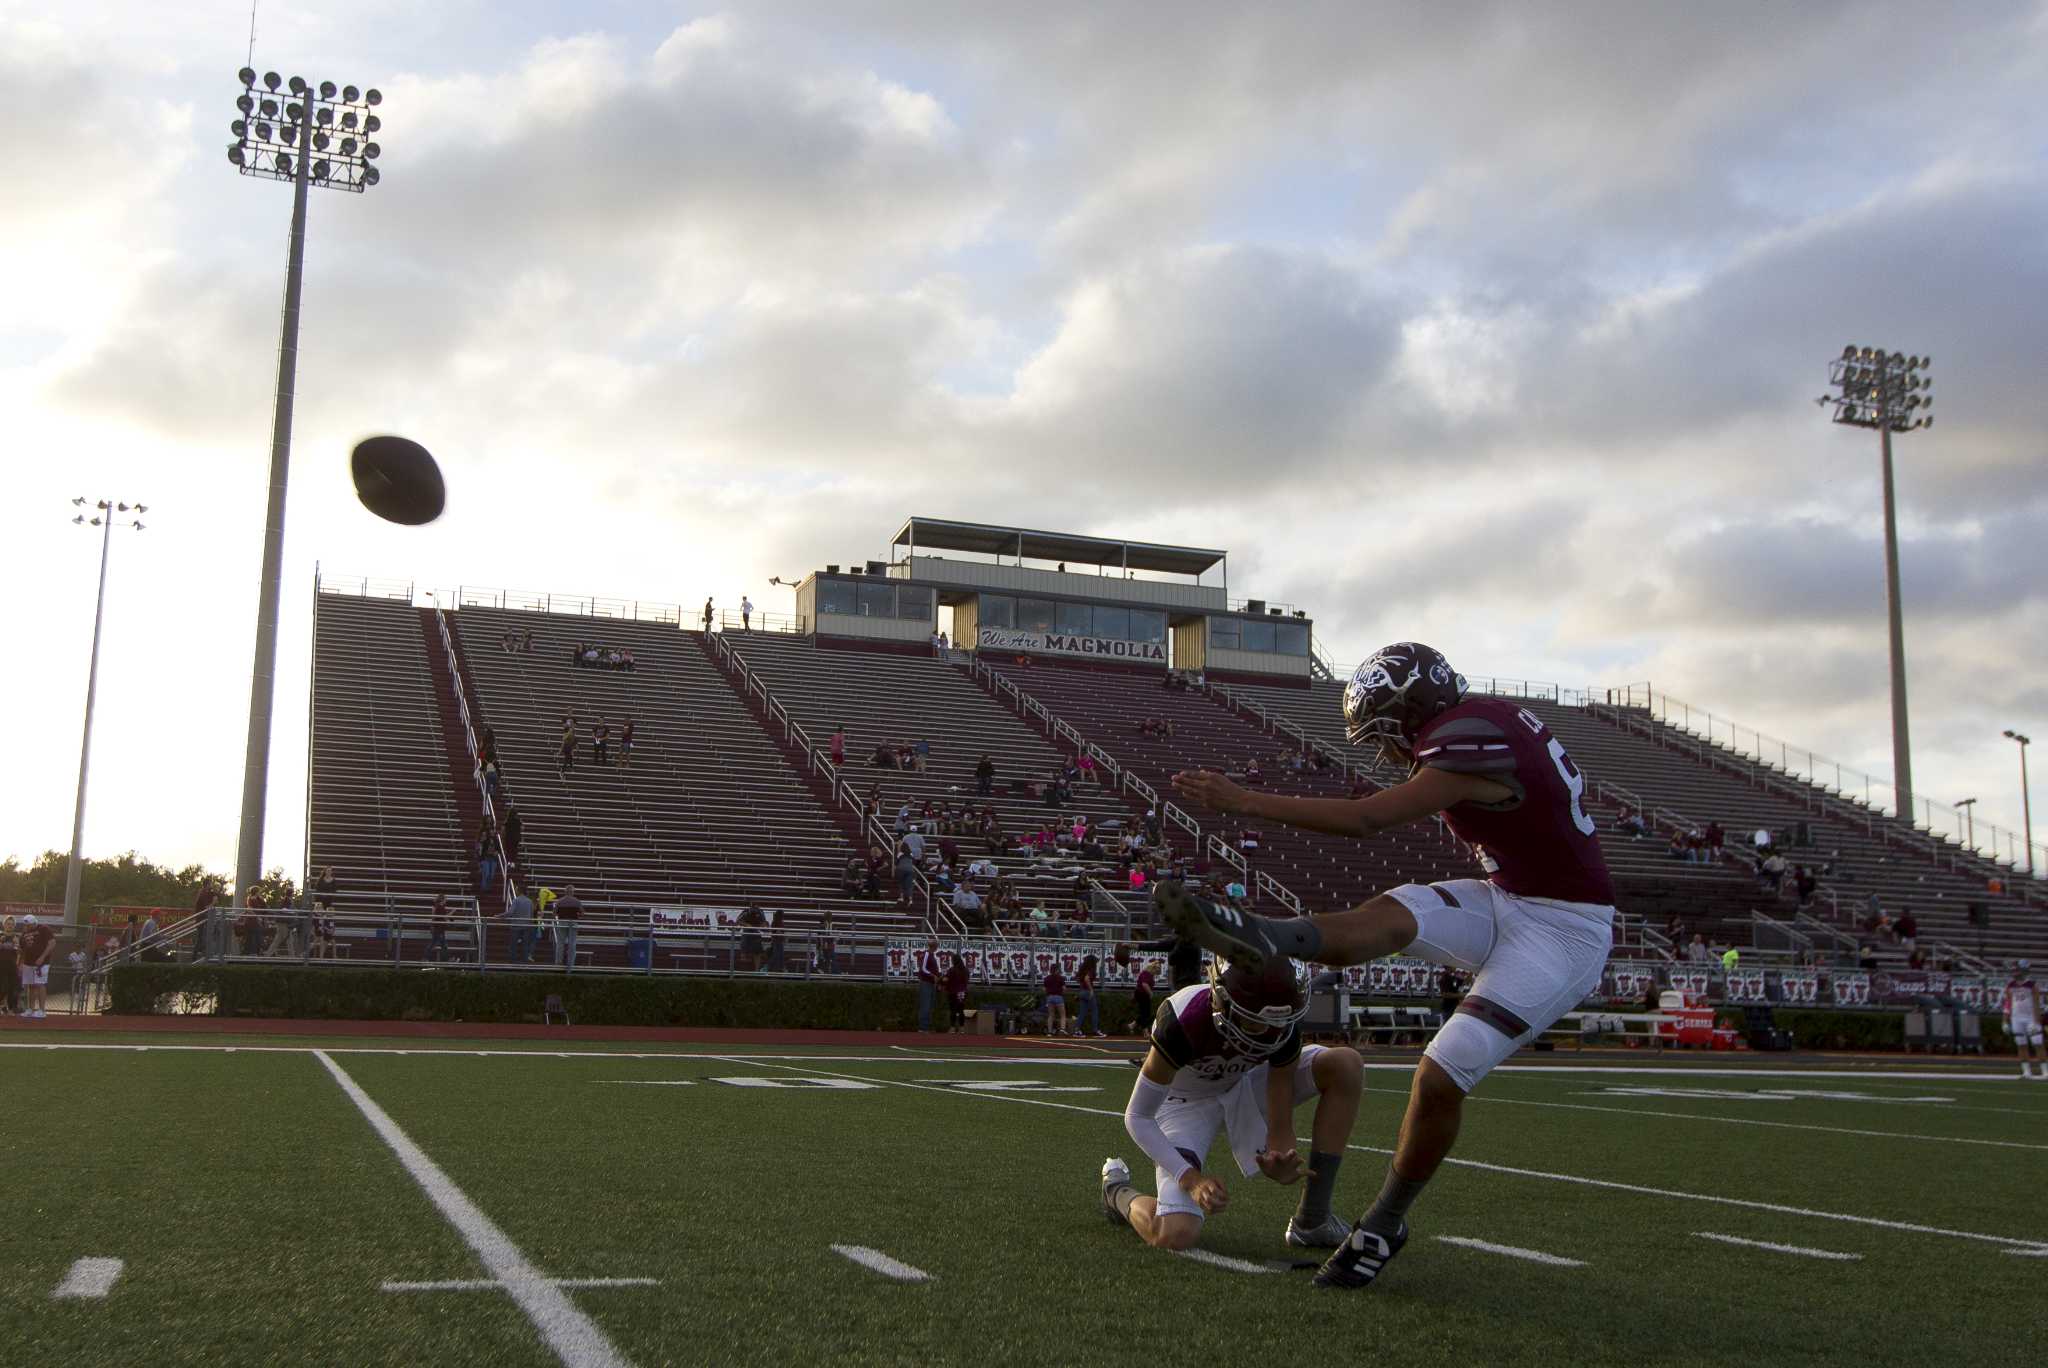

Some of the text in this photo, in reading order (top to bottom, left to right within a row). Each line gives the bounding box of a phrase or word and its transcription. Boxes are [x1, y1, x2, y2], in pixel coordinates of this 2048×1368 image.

[982, 630, 1165, 659] We Are MAGNOLIA
